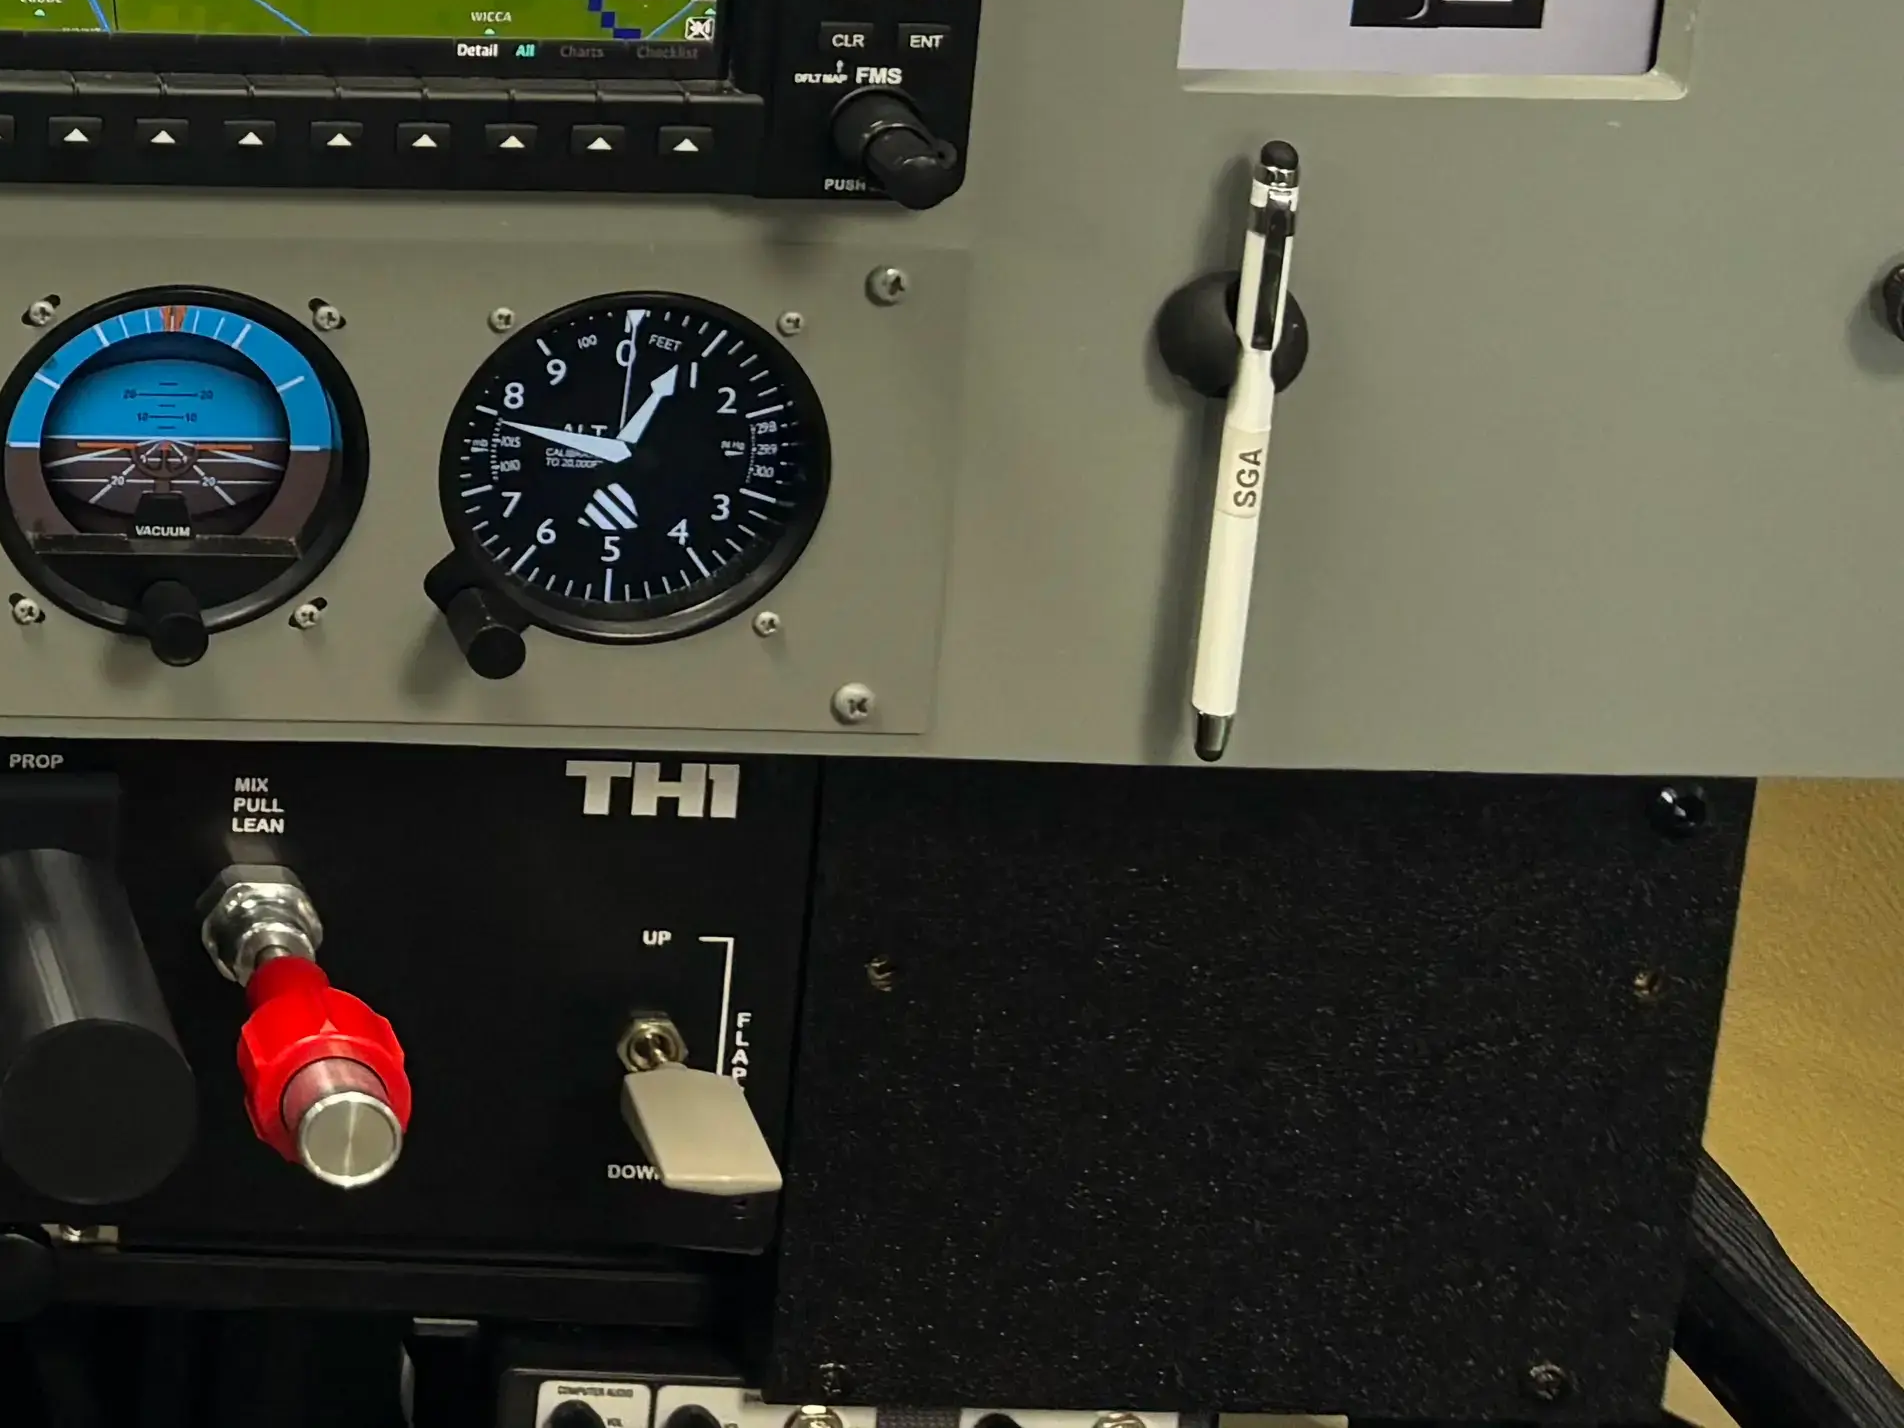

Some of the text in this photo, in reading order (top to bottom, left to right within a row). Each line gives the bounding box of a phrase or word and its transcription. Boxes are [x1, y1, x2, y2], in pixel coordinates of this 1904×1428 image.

[457, 43, 534, 58] Detail All
[1233, 449, 1262, 508] SGA
[135, 525, 190, 538] VACUUM
[10, 754, 64, 770] PROP
[235, 778, 268, 792] MIX
[234, 798, 283, 813] PULL
[233, 818, 284, 834] LEAN
[644, 930, 671, 945] UP
